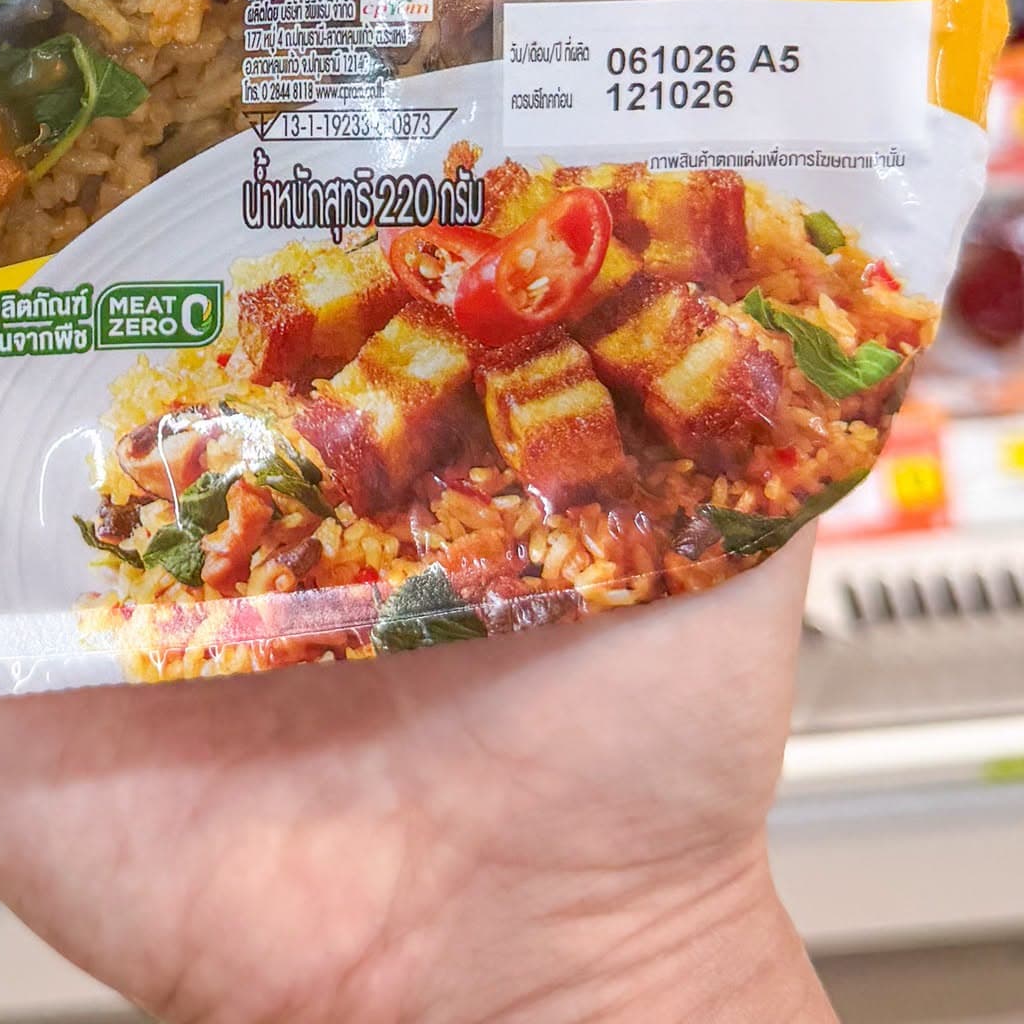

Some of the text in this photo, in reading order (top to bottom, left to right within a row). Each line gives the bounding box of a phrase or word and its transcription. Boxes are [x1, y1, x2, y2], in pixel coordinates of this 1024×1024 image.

[247, 30, 261, 48] 177
[510, 36, 801, 75] วัน/เดือน/ปี ที่ผลิต 061026 A5
[270, 85, 290, 101] 2844
[293, 83, 313, 100] 8118
[511, 81, 734, 112] ควรบริโภคก่อน 121026
[244, 148, 485, 244] น้ำหนักสุทธิ 220 กรัม
[109, 295, 176, 317] MEAT
[109, 317, 176, 337] ZERO
